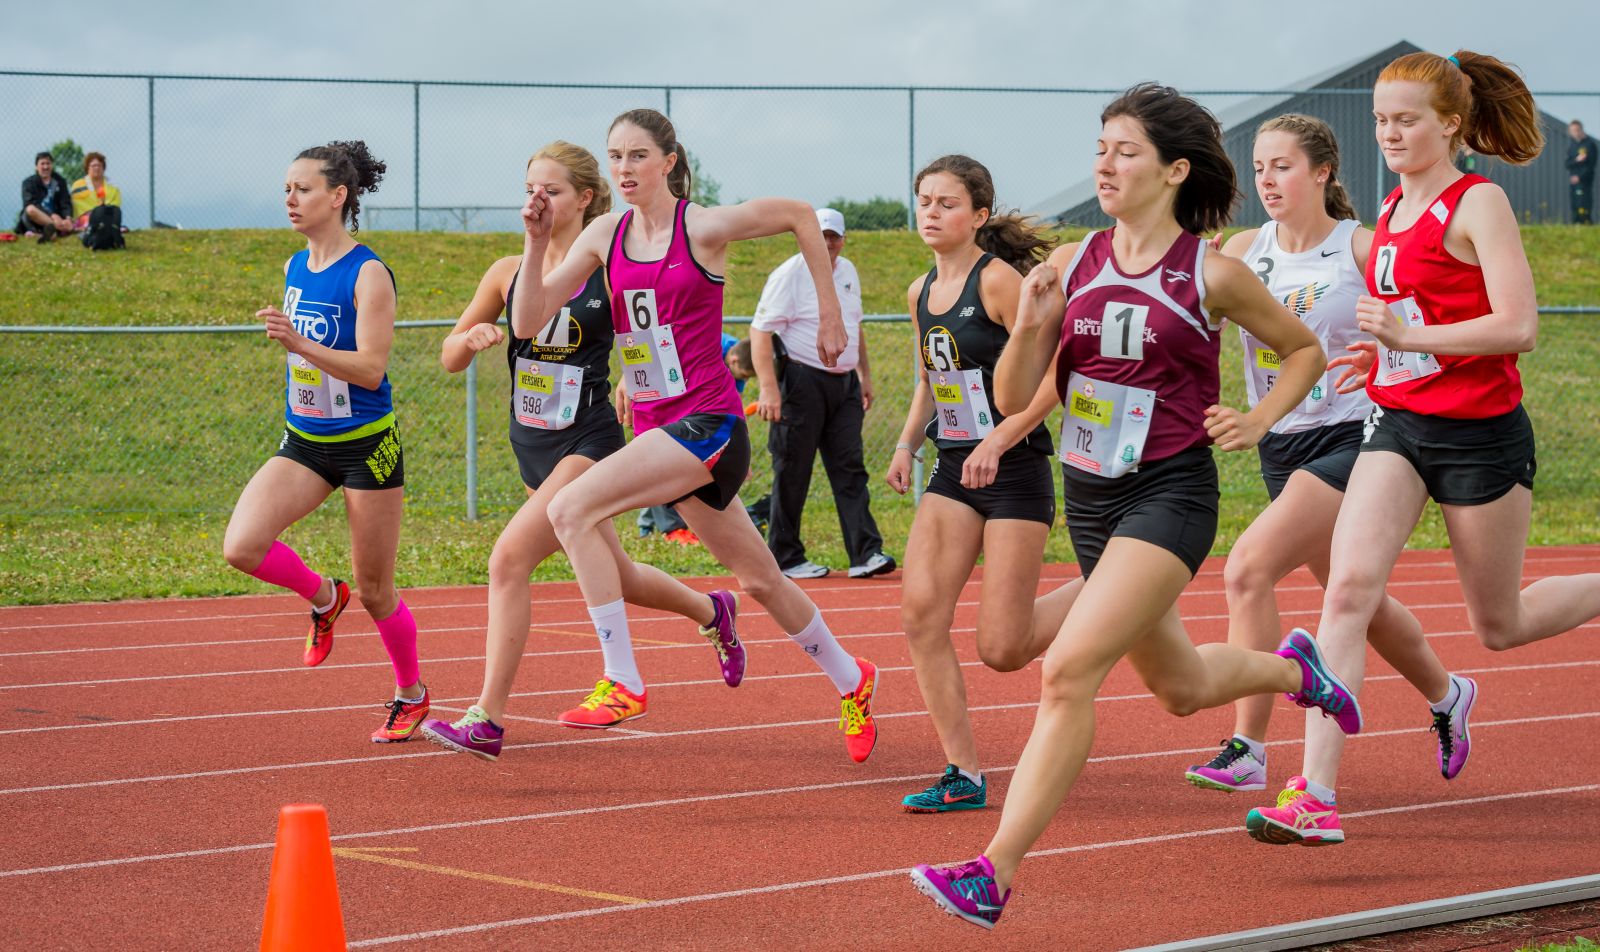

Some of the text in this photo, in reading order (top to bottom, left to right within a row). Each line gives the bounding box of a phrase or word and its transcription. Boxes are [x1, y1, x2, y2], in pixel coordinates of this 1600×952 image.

[1257, 257, 1275, 287] 3
[1381, 249, 1394, 291] 2
[284, 289, 297, 319] 8
[632, 291, 651, 330] 6
[1115, 307, 1135, 356] 1
[934, 336, 951, 371] 5
[1387, 349, 1404, 369] 672
[521, 375, 544, 388] HERSHEY
[634, 369, 650, 388] 472
[298, 388, 316, 406] 582
[522, 395, 542, 415] 598
[1075, 397, 1099, 417] HERSHEY
[1076, 425, 1093, 454] 712
